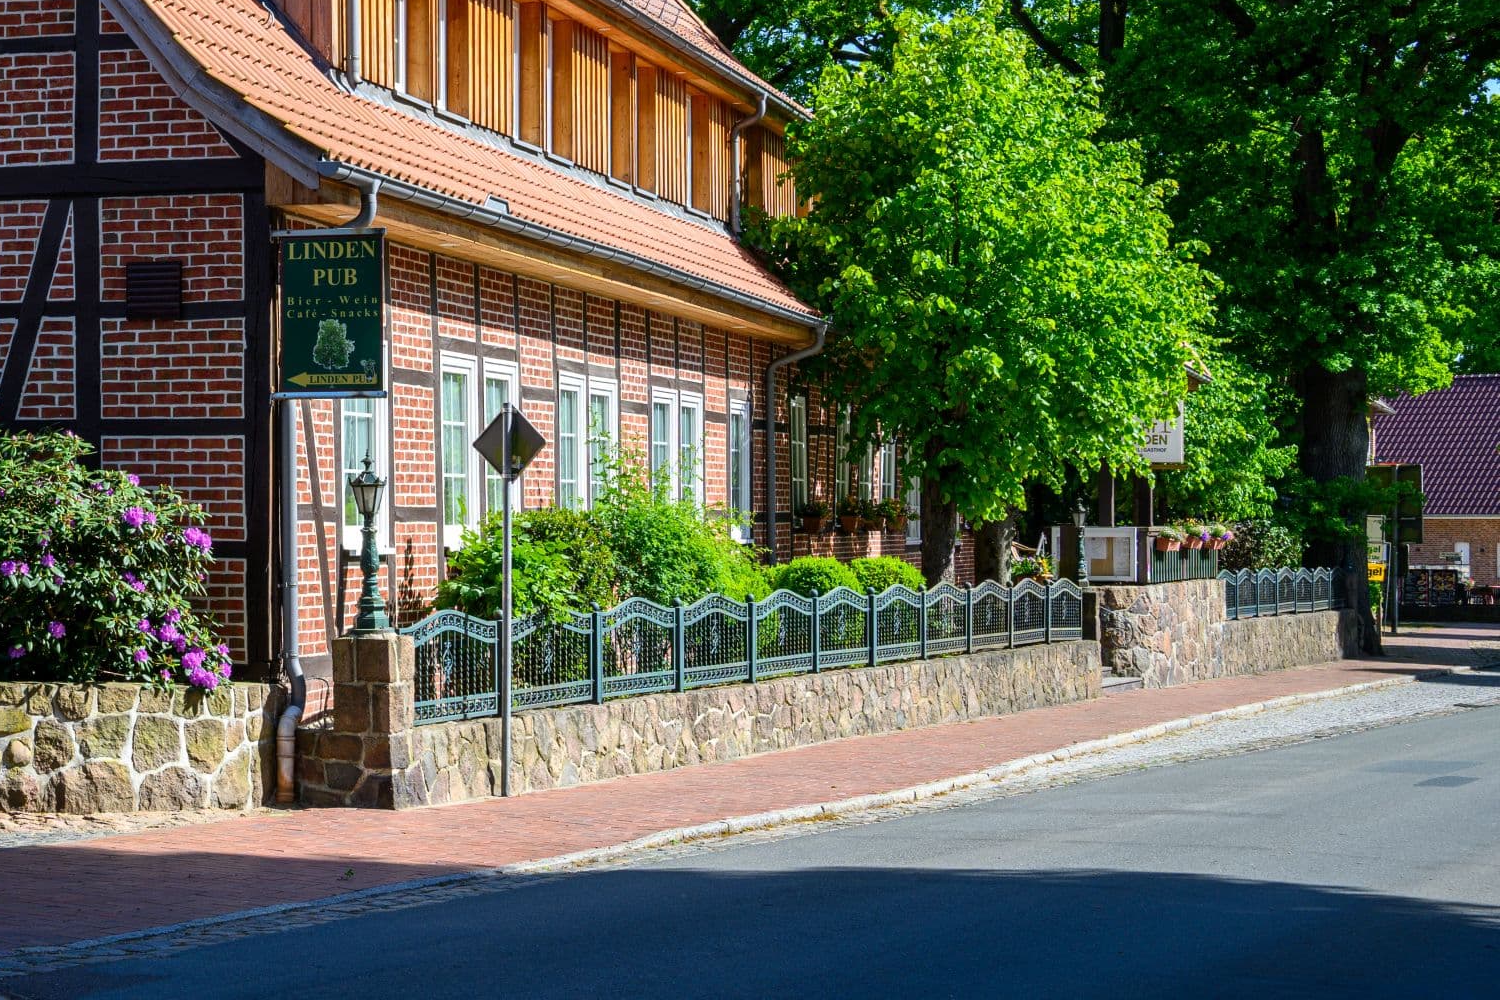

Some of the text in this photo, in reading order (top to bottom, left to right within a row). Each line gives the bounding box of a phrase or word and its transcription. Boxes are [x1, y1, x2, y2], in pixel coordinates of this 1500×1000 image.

[288, 241, 375, 260] LINDEN
[313, 267, 358, 286] PUB
[287, 296, 321, 306] Bier
[339, 295, 378, 304] Wein
[286, 308, 317, 319] Café
[330, 308, 378, 318] Snacks
[309, 375, 349, 384] LINDEN
[1367, 567, 1382, 577] gel
